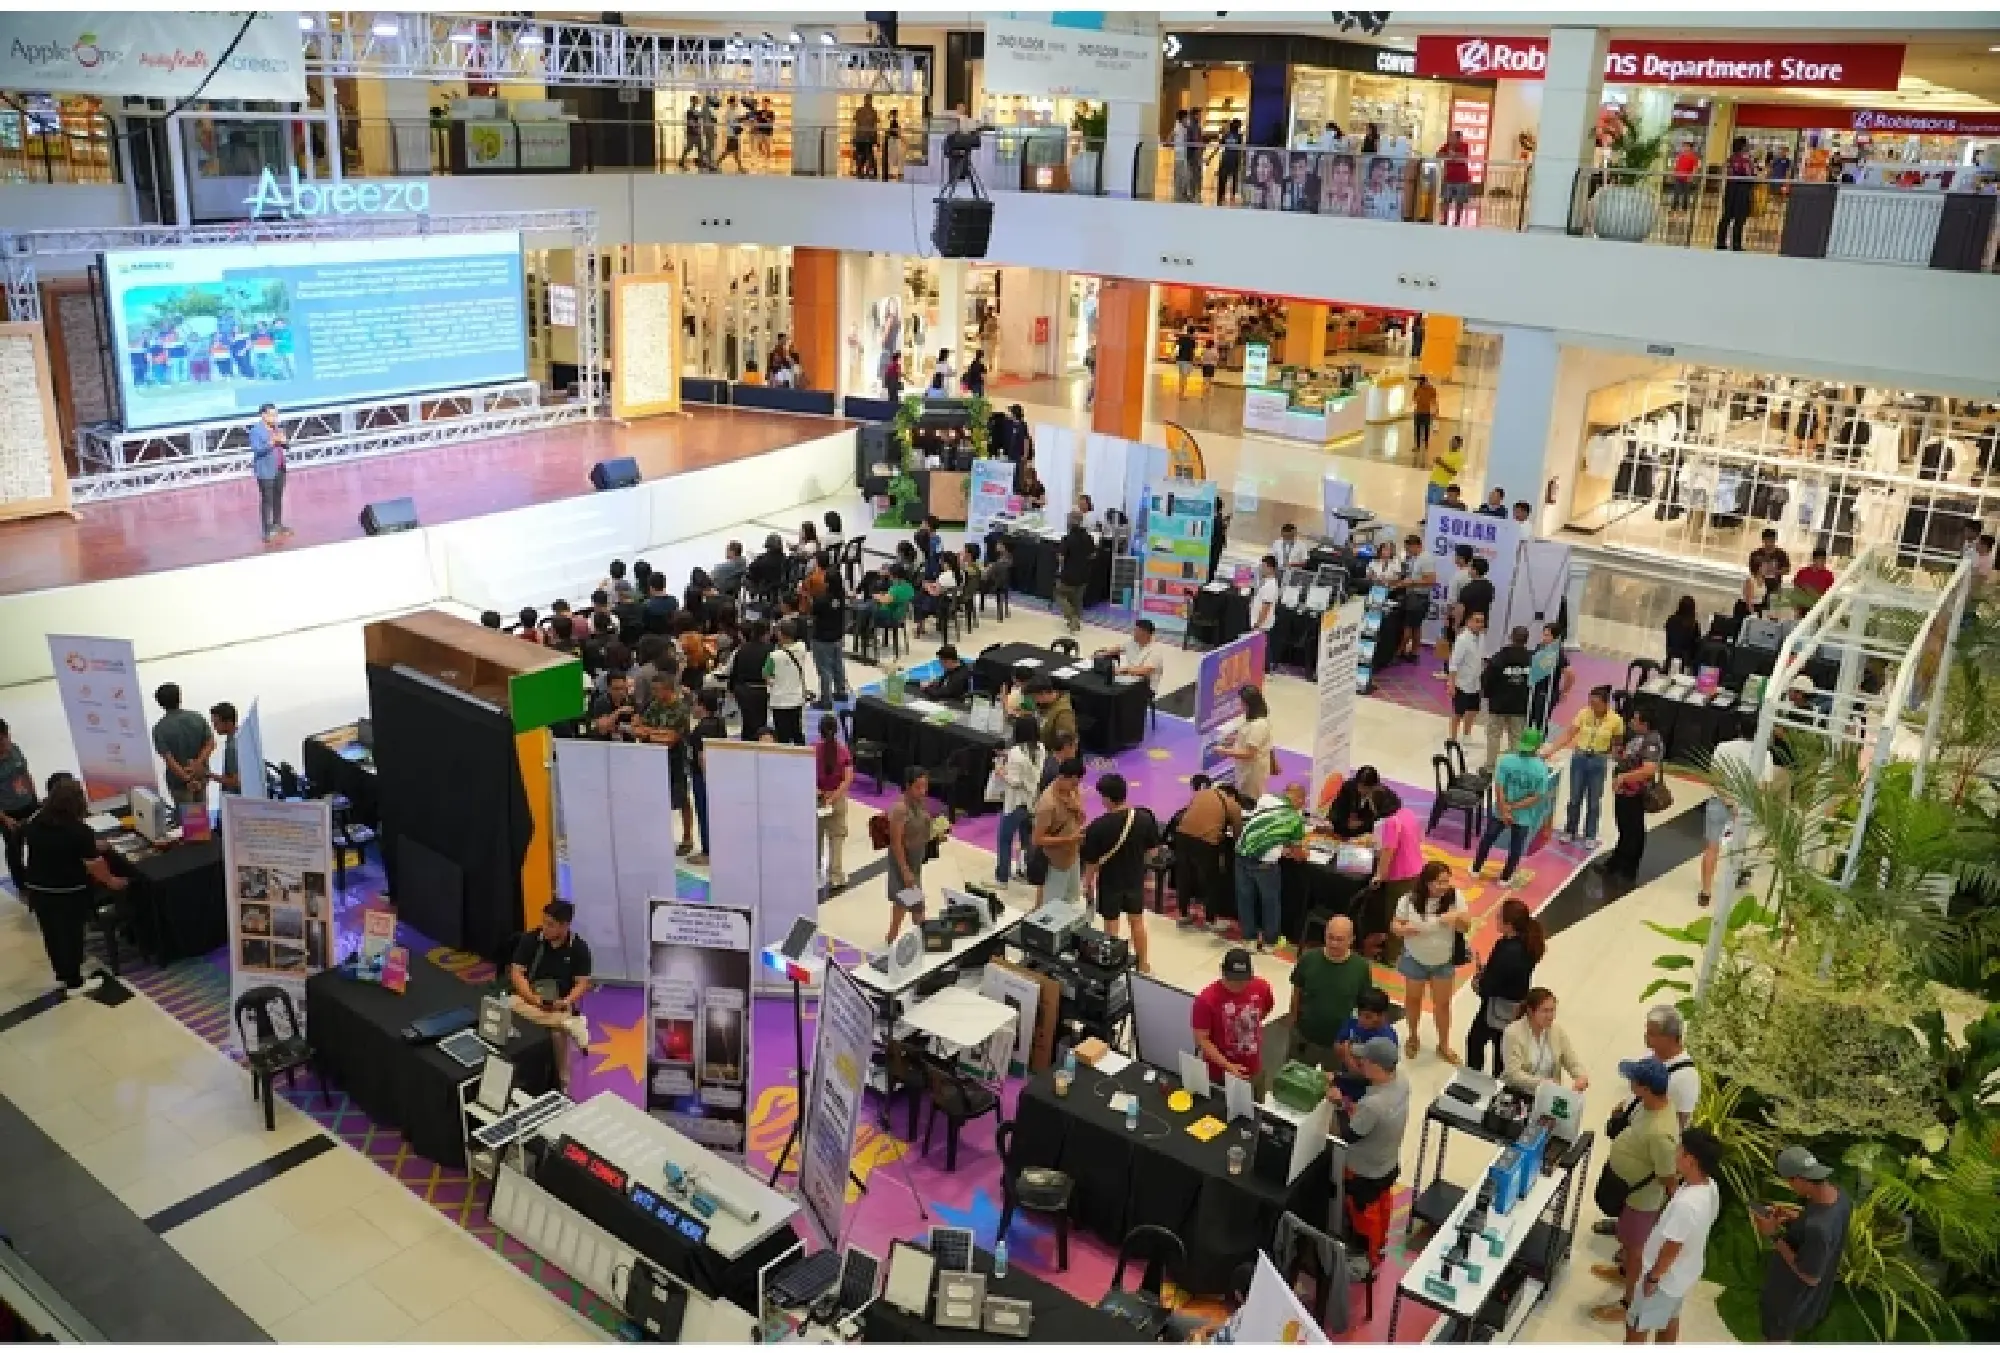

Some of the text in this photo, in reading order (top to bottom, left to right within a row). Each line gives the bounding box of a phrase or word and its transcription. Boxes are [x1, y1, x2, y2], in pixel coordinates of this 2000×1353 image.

[1643, 53, 1774, 80] Department
[1780, 57, 1843, 81] Store
[243, 163, 430, 219] Abreeza
[1438, 515, 1498, 542] SOLAR
